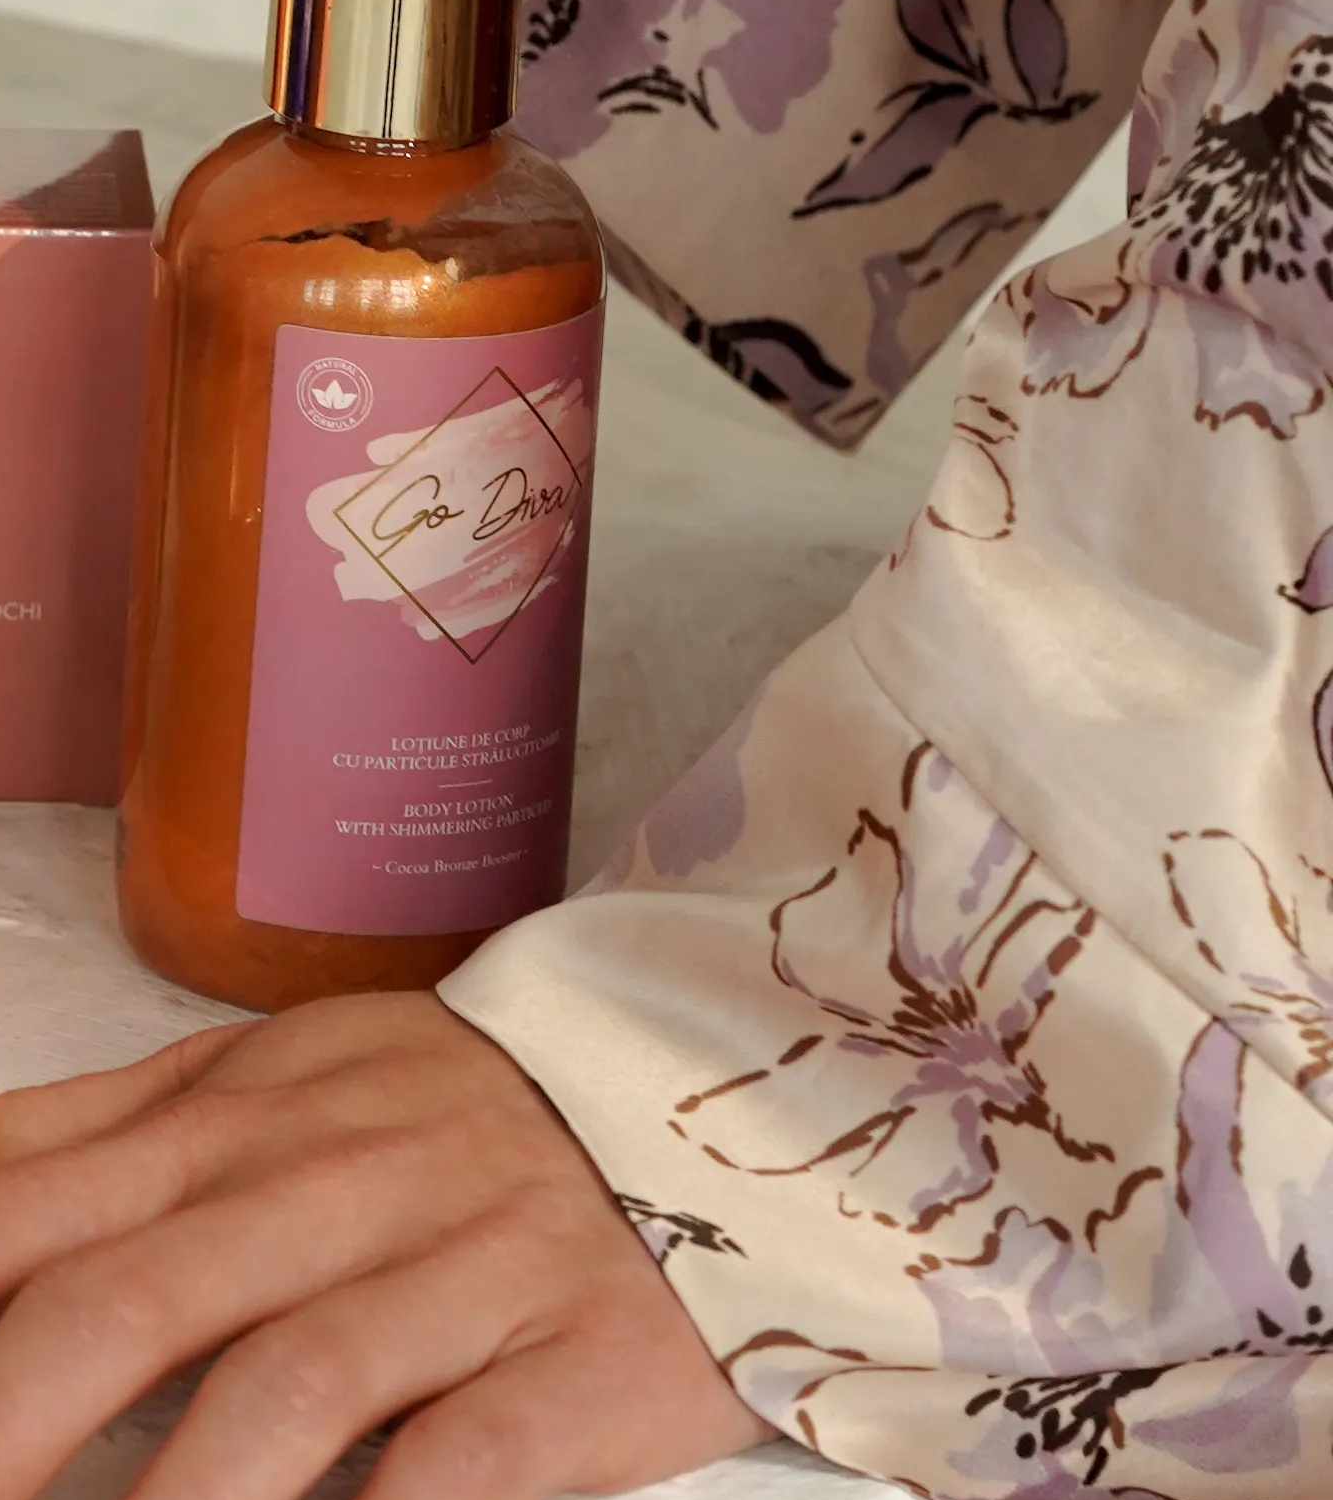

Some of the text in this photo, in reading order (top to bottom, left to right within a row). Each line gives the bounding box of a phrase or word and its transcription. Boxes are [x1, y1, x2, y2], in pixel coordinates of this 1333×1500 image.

[313, 358, 358, 376] NATURAL
[307, 408, 357, 430] FORMULA
[372, 467, 565, 541] Go Diva
[471, 732, 492, 748] DE
[494, 724, 532, 744] CORP
[332, 752, 361, 768] CU
[364, 754, 458, 771] PARTICULE
[403, 792, 515, 818] BODY LOTION
[334, 819, 385, 837] WITH
[389, 816, 494, 837] SHIMMERING
[385, 860, 430, 875] Cocoa
[434, 857, 478, 874] Bronze
